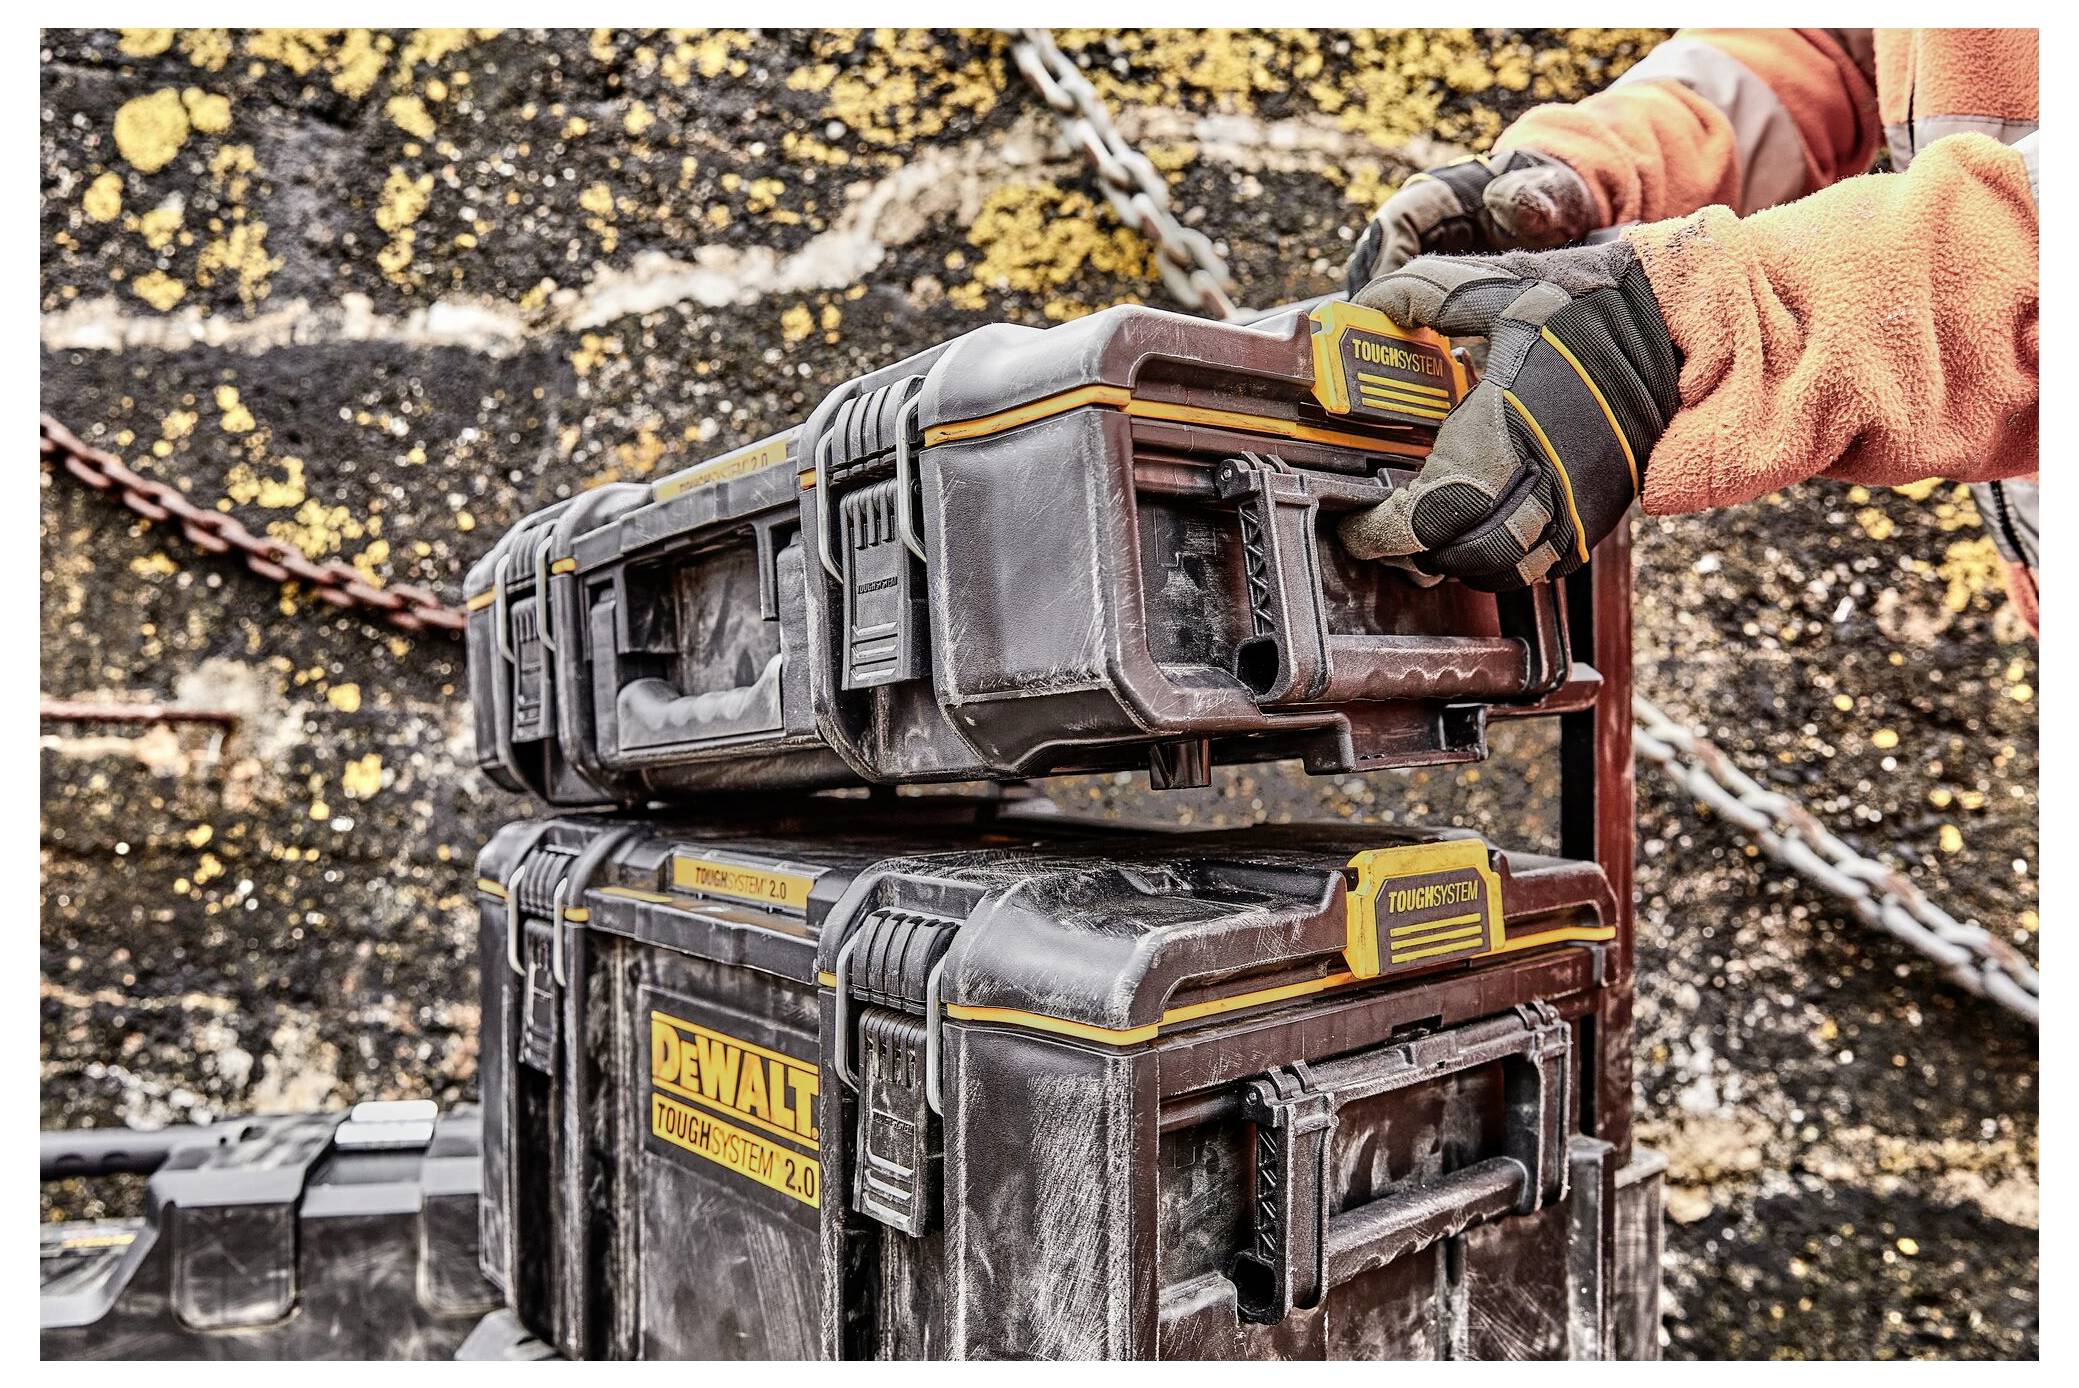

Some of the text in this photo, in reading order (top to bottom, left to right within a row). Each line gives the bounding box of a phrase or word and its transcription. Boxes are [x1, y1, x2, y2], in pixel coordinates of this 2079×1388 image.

[1352, 338, 1444, 378] TOUGHSYSTEM
[695, 866, 787, 900] TOUGHSYSTEM 2.0
[1388, 879, 1479, 914] TOUGHSYSTEM
[657, 1102, 815, 1199] TOUGHSYSTEM 2.0
